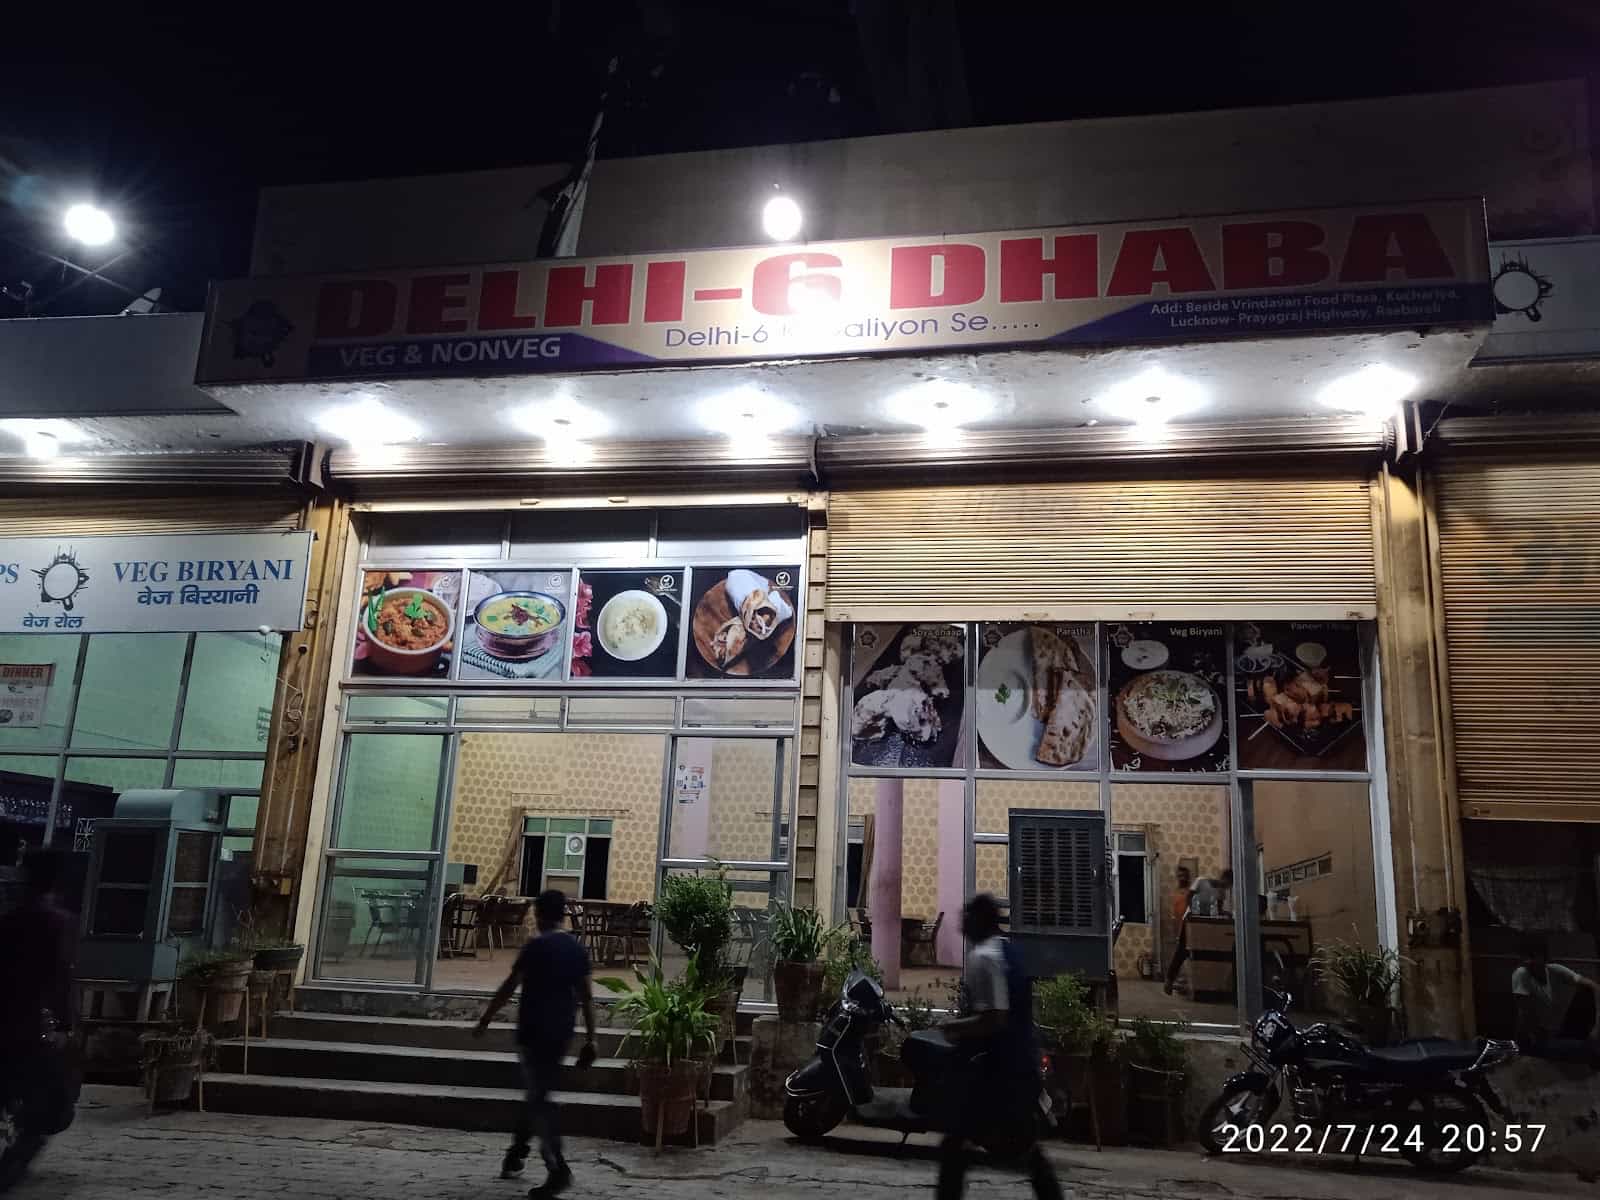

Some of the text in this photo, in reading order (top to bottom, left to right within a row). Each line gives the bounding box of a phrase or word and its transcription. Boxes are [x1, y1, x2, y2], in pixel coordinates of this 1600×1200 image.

[316, 213, 1455, 338] DELHI-6 DHABA
[1151, 303, 1182, 315] Add:
[1186, 301, 1228, 313] Beside
[665, 324, 769, 348] Delhi-6
[833, 317, 939, 341] aliyon
[340, 336, 562, 368] VEG & NONVEG
[112, 559, 296, 583] VEG BIRYANI
[137, 586, 173, 606] वेज
[23, 612, 84, 629] वेज रोल
[1170, 627, 1223, 638] Veg Biryani
